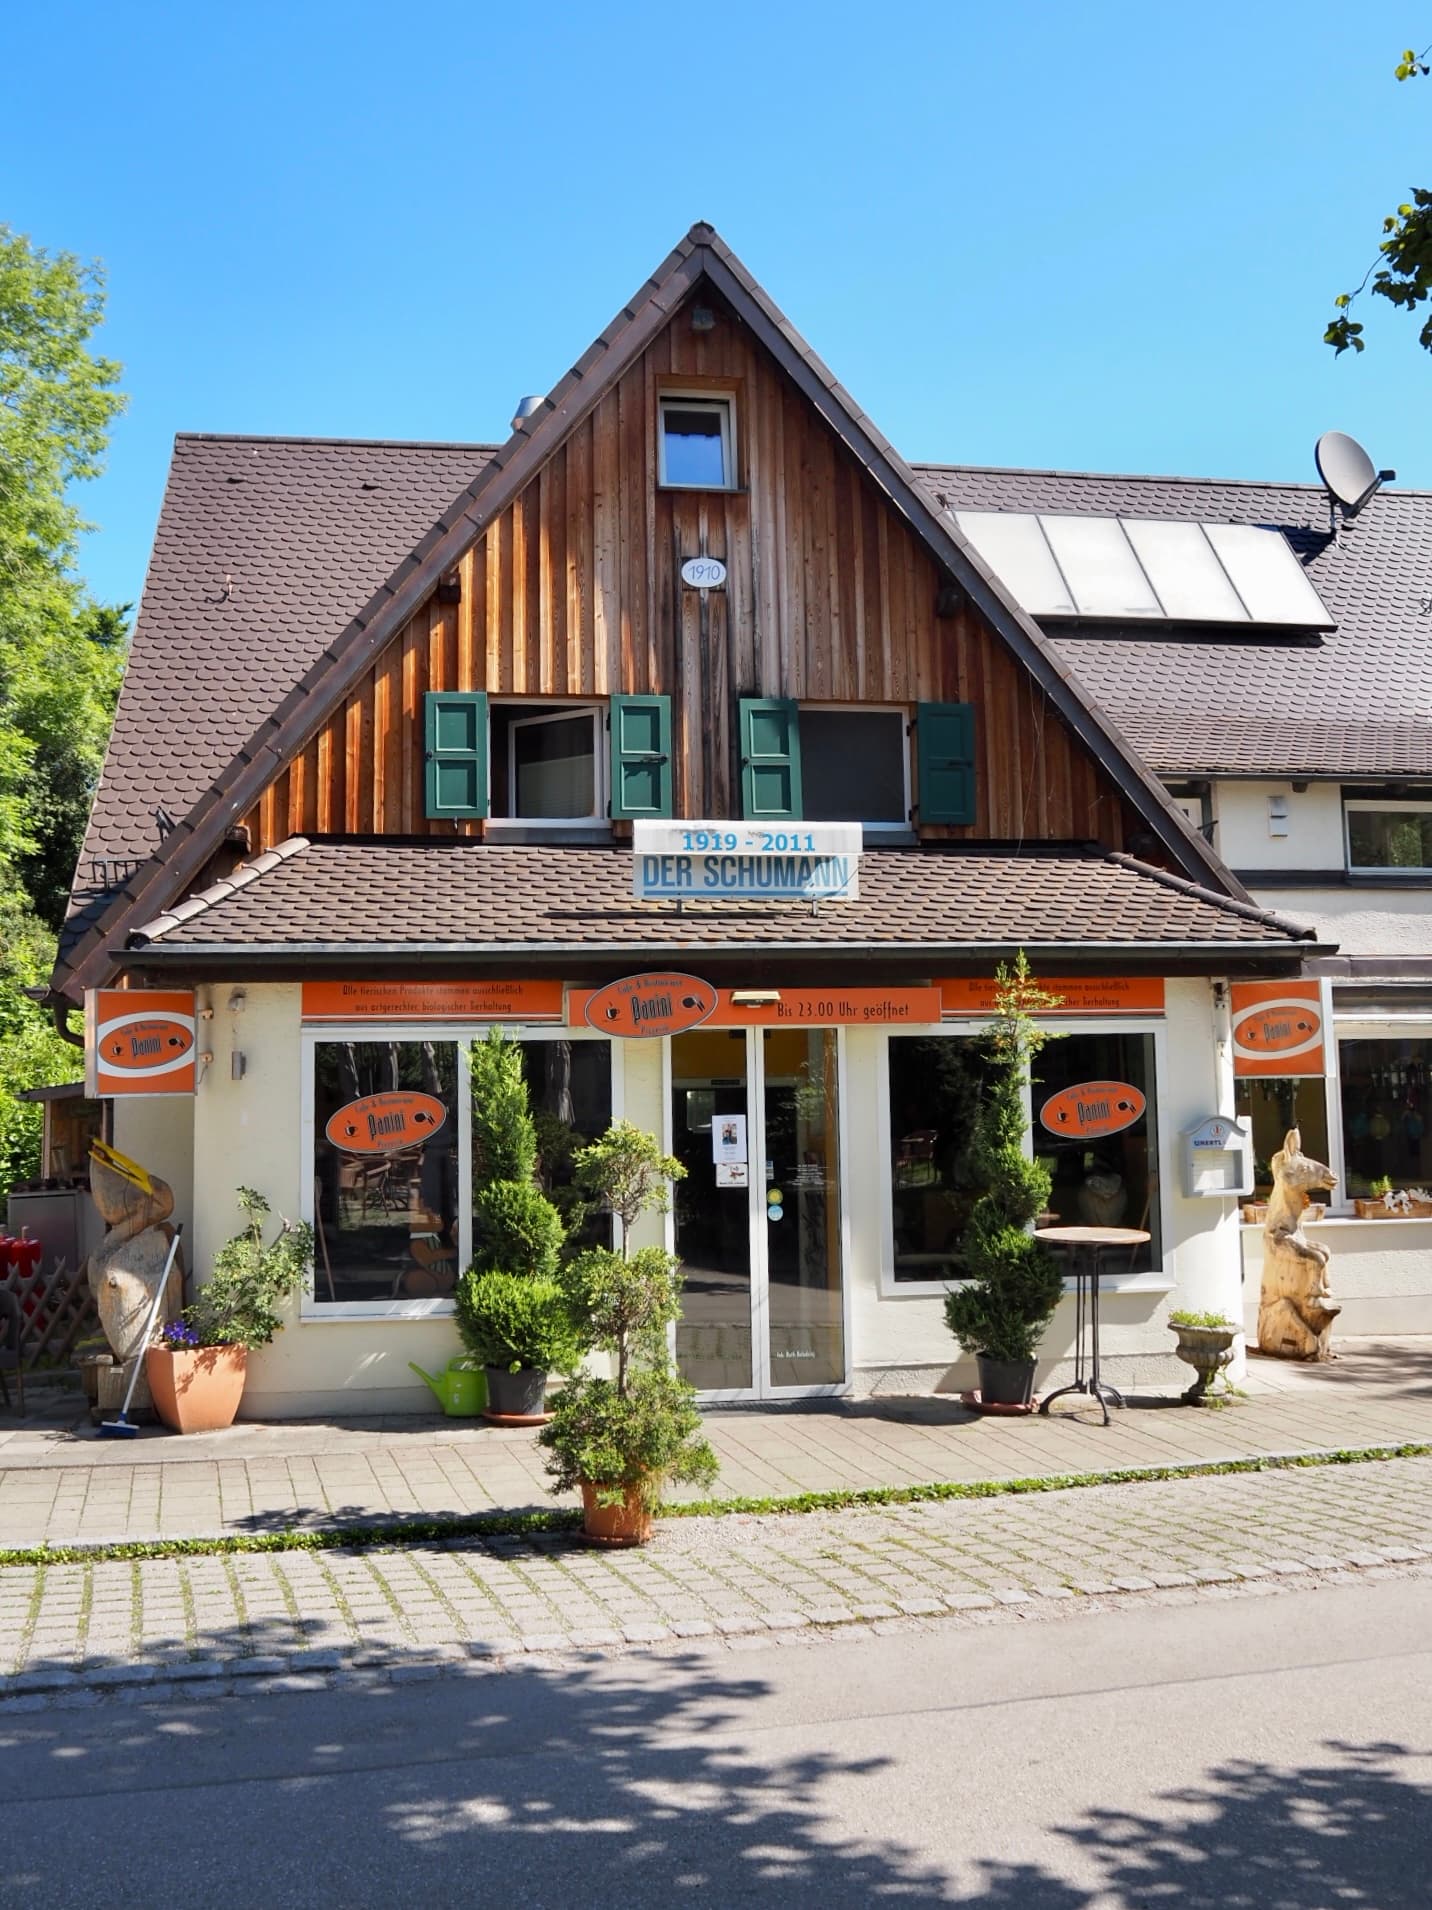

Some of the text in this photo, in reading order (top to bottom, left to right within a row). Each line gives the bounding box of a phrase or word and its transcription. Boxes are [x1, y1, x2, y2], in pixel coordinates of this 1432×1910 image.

[687, 564, 721, 581] 1910
[683, 832, 737, 851] 1919
[762, 833, 816, 851] 2011
[643, 855, 849, 888] DER SCHUMANN
[631, 993, 673, 1025] Panini
[777, 1001, 909, 1020] Bis 23.00 Uhr geöffnet
[367, 1110, 406, 1140] Panini
[1077, 1099, 1111, 1126] Panini
